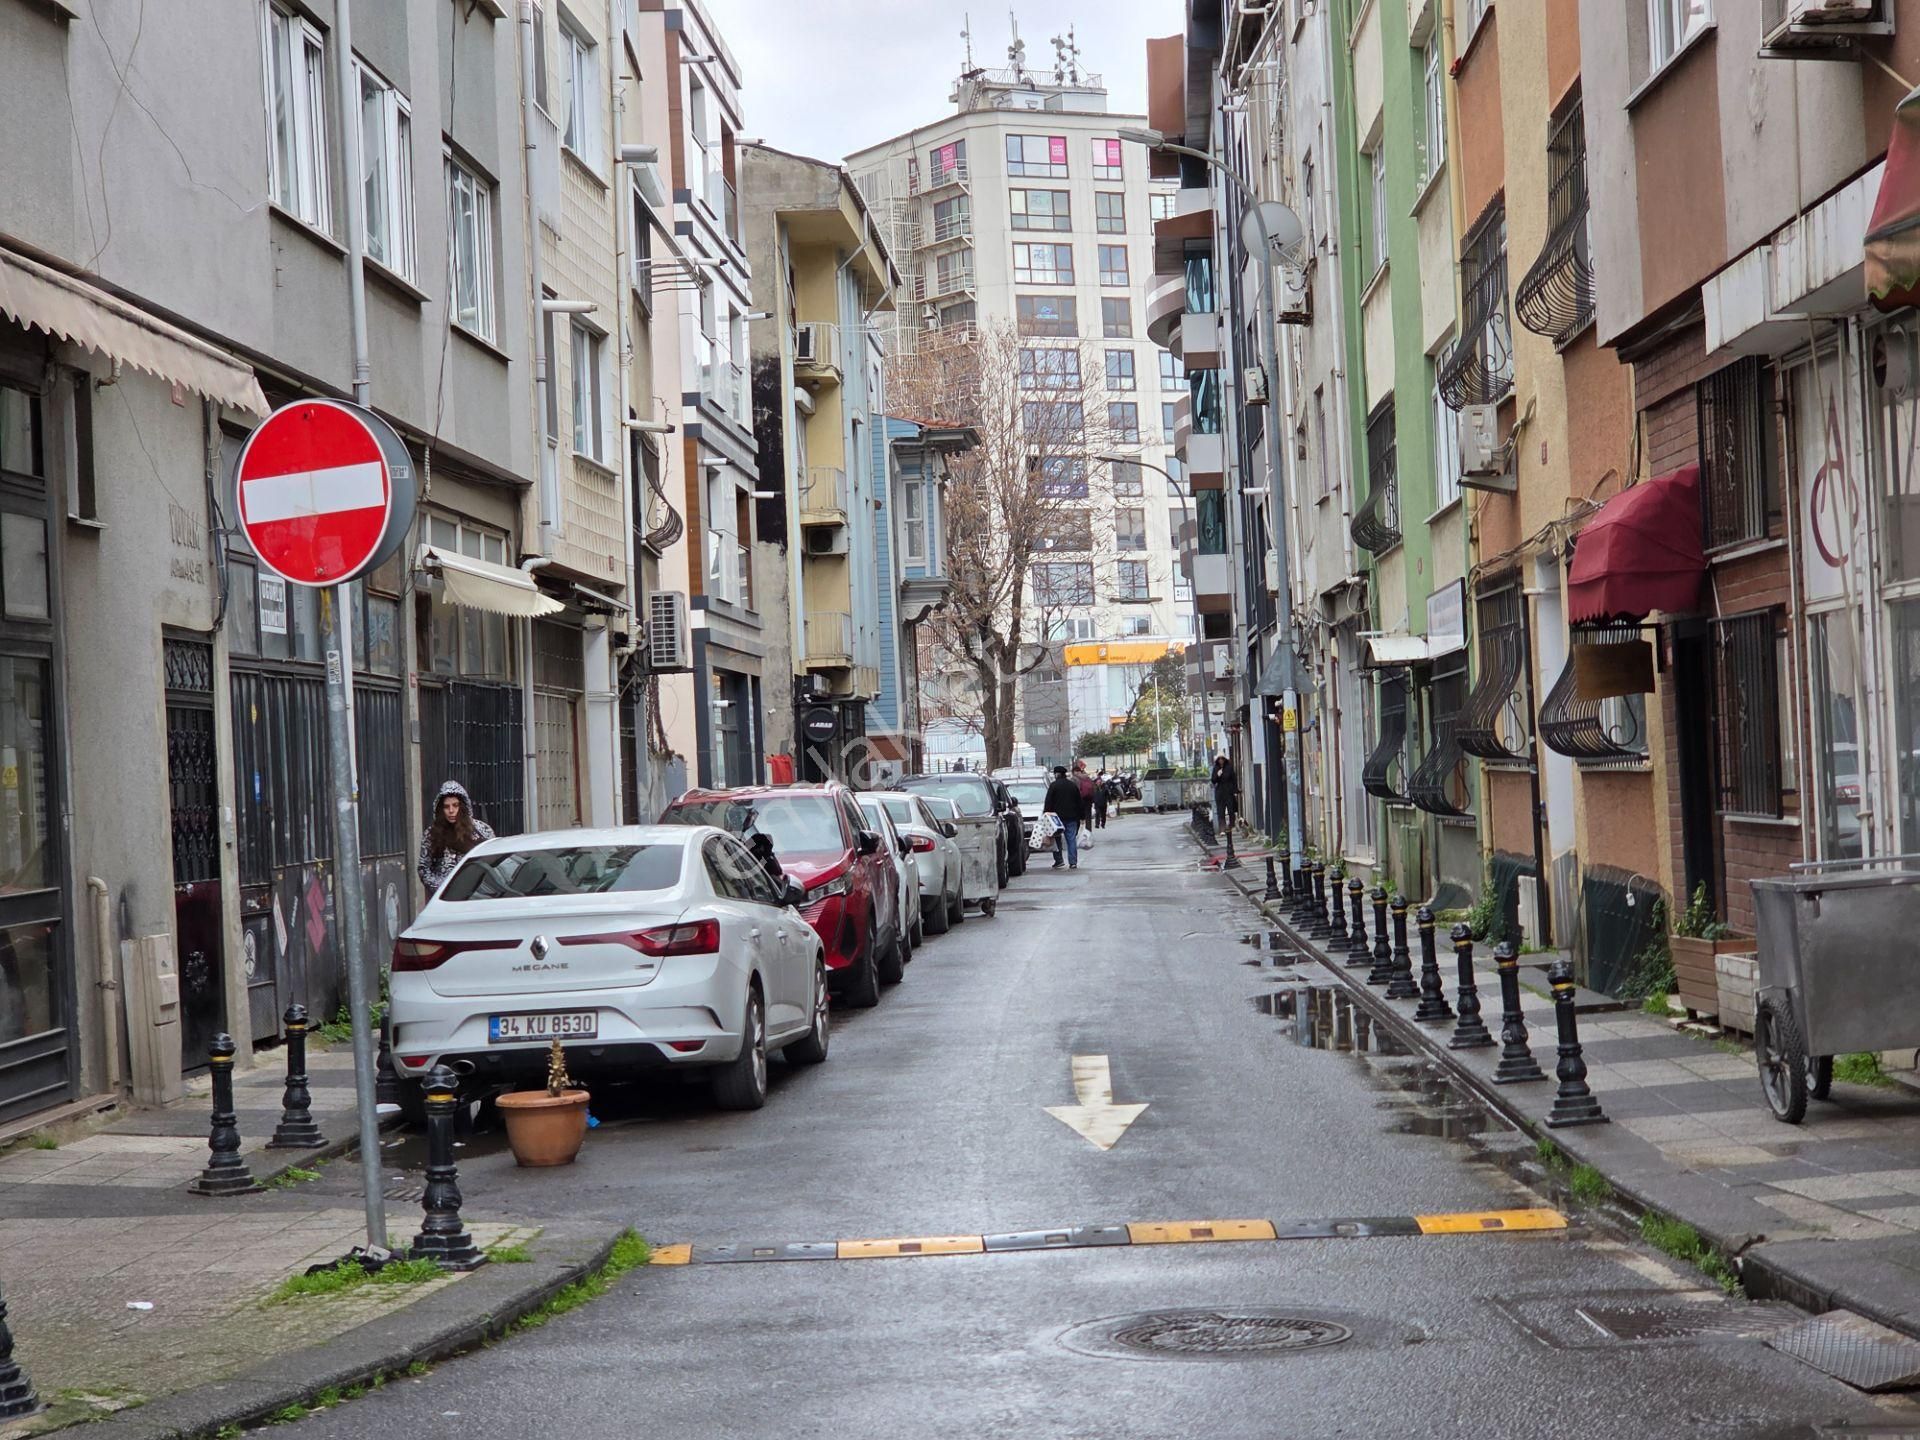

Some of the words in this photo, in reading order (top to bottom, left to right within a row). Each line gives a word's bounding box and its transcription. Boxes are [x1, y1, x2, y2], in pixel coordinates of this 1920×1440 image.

[512, 963, 569, 972] MEGANE
[501, 1018, 519, 1035] 34
[526, 1017, 546, 1034] KU
[552, 1015, 592, 1033] 8530
